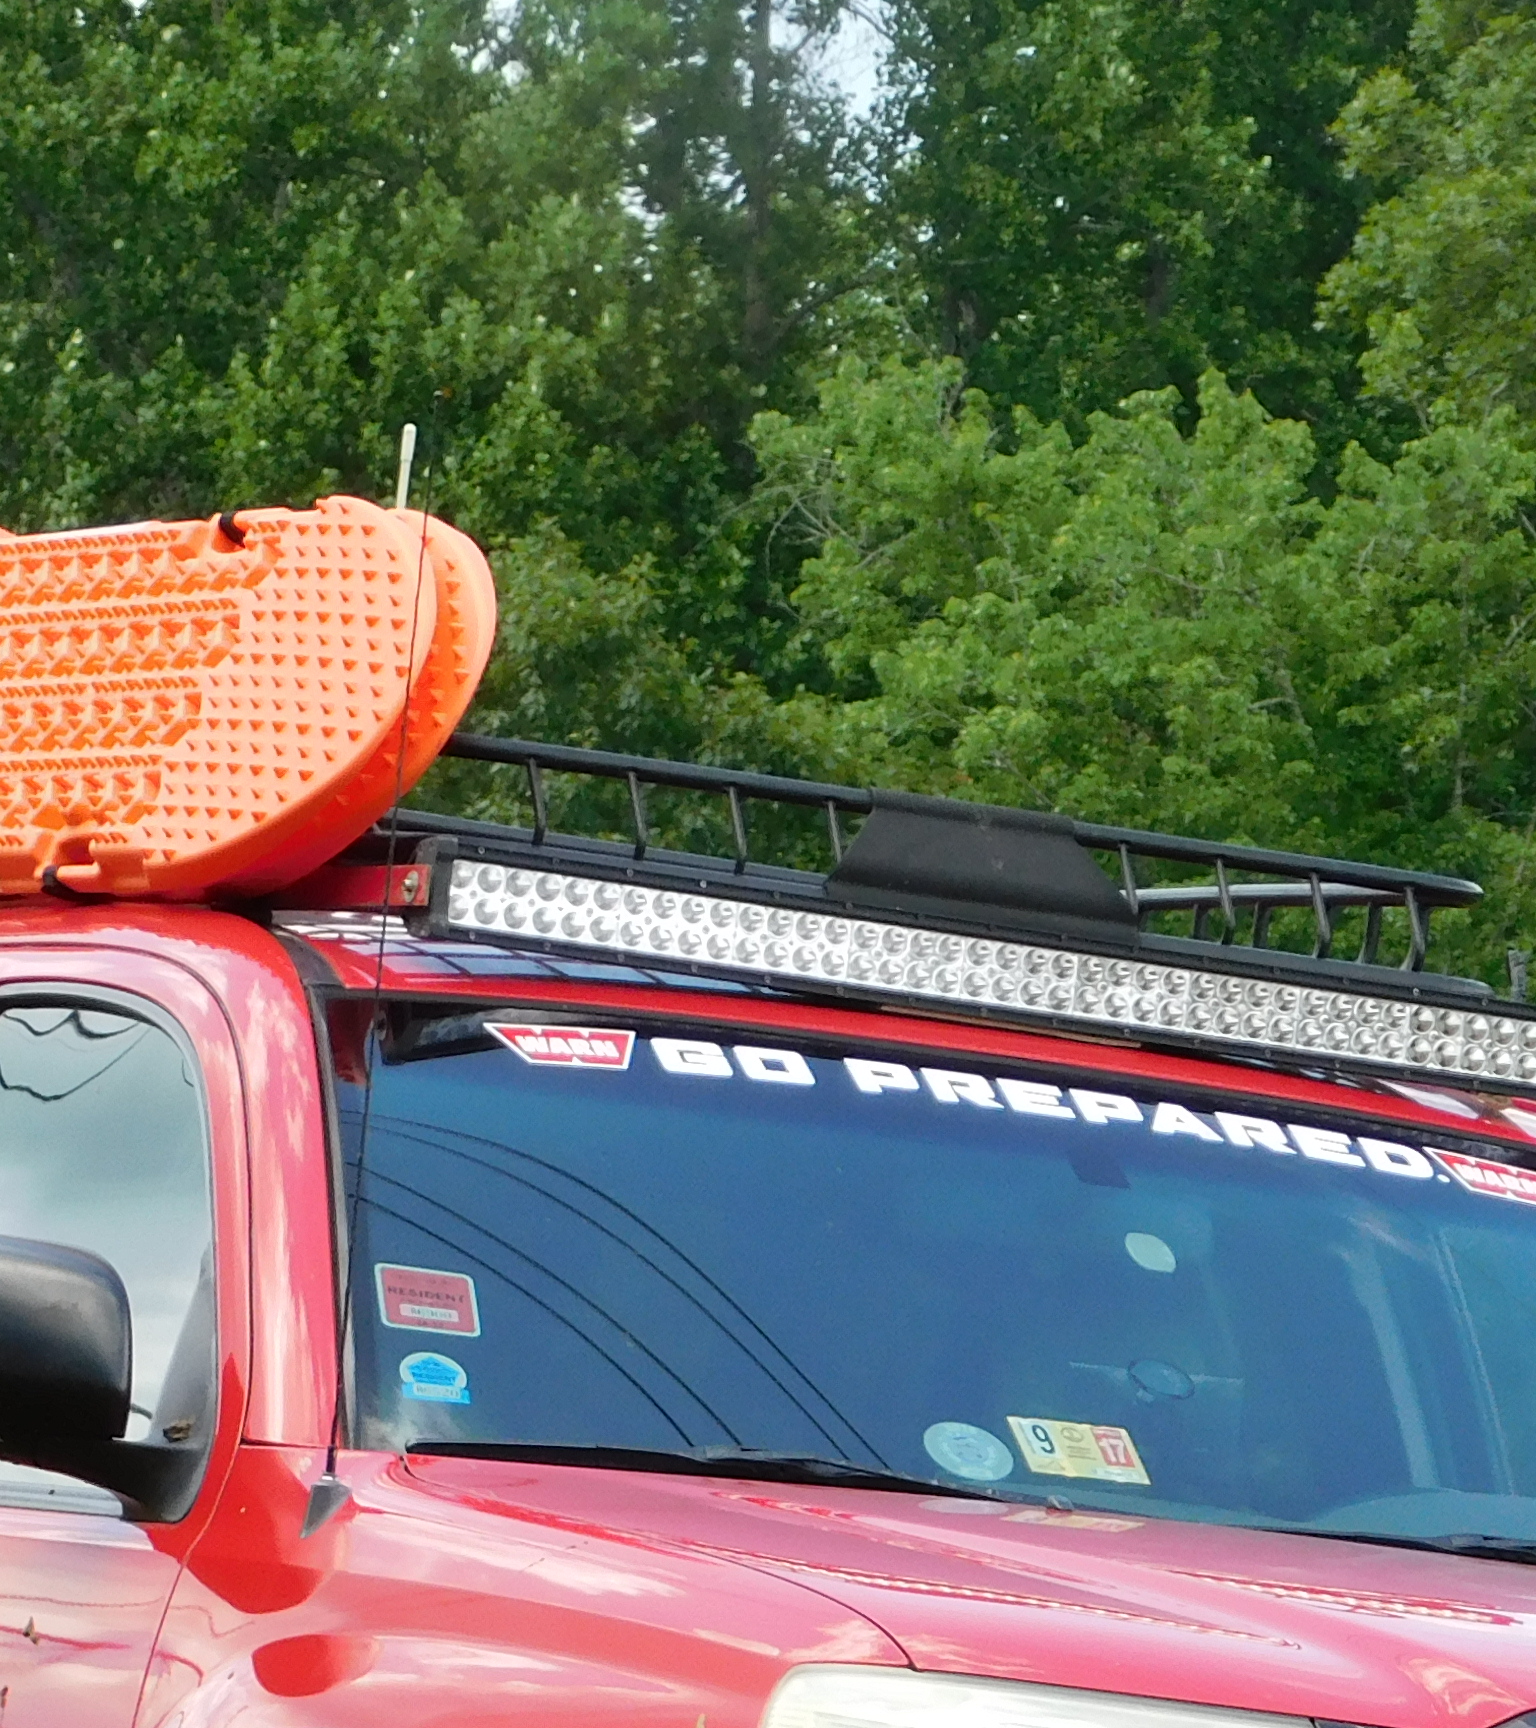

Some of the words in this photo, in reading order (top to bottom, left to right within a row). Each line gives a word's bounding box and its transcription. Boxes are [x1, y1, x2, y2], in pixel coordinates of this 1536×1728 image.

[514, 1034, 620, 1058] WARN
[650, 1037, 816, 1085] GO
[843, 1057, 1451, 1184] PREPARED.
[1031, 1424, 1055, 1455] 9
[1098, 1437, 1128, 1464] 17
